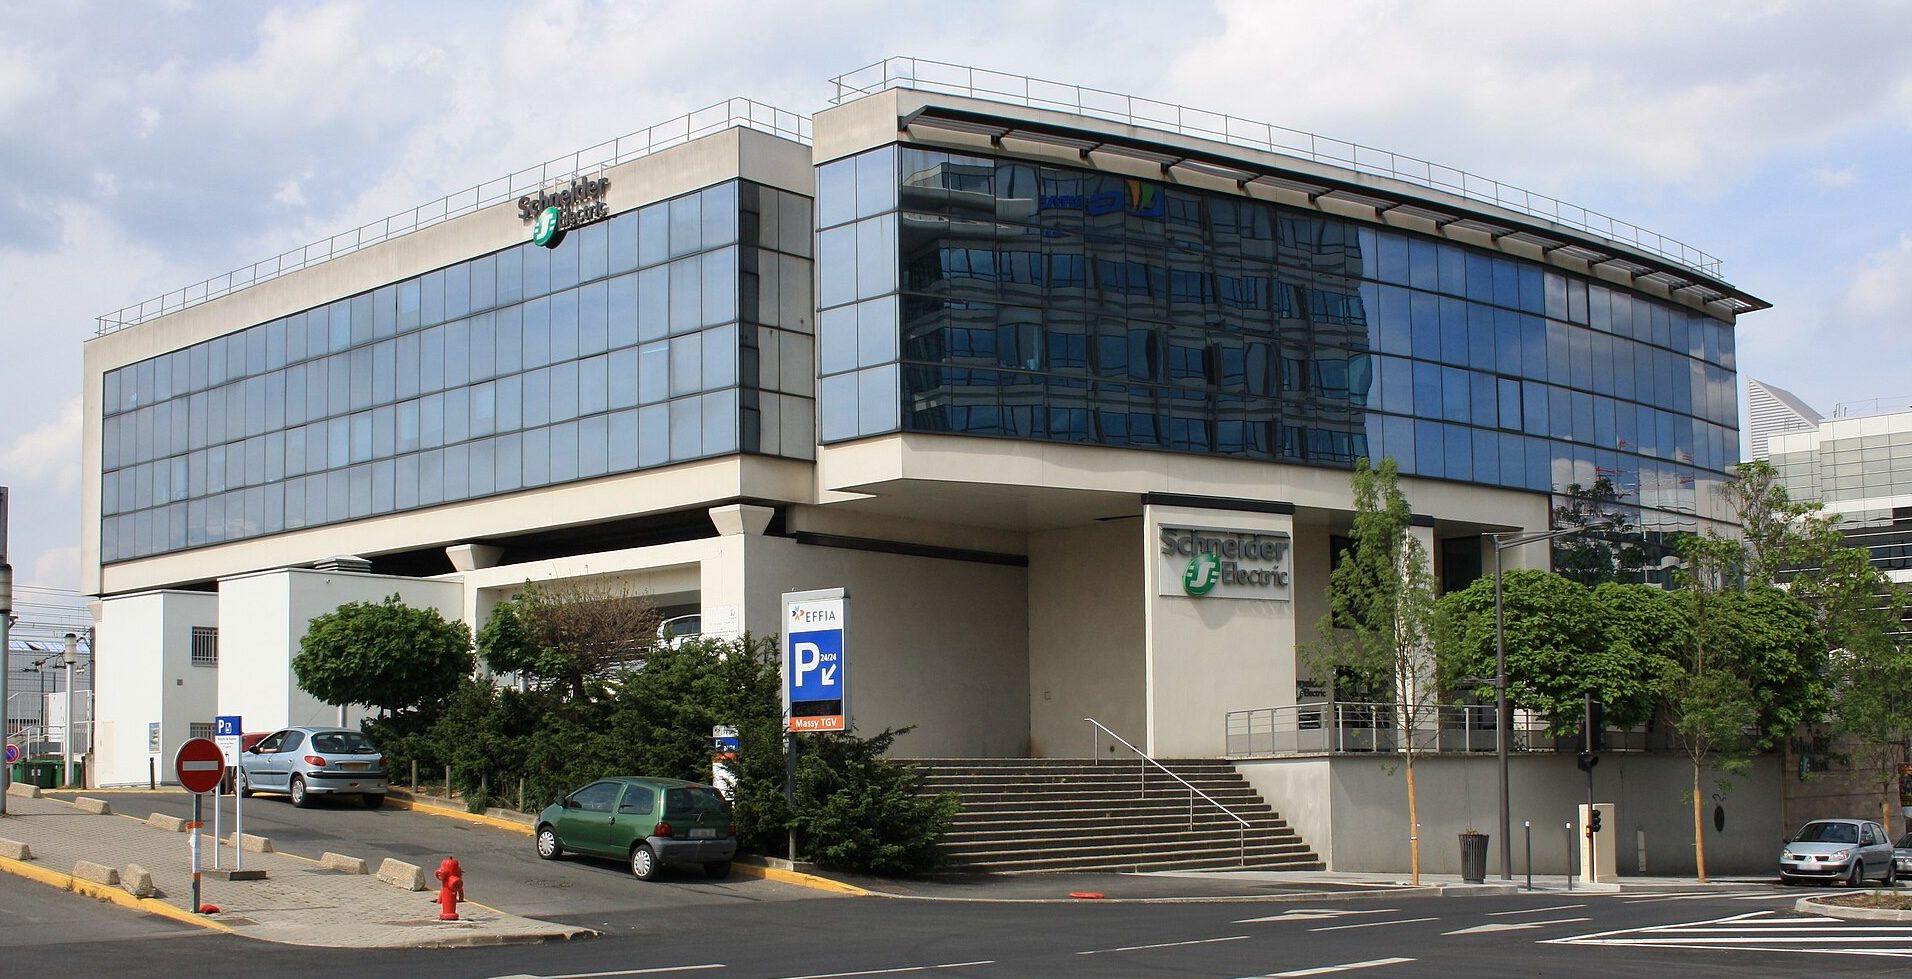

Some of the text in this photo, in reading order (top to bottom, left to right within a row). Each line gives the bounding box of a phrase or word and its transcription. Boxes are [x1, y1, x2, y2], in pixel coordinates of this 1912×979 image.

[518, 176, 608, 220] Schneider
[557, 201, 608, 230] Electric
[1161, 529, 1288, 562] Schneider
[1221, 561, 1288, 587] Electric
[805, 610, 836, 623] EFFIA
[795, 642, 837, 687] P 24/24
[218, 719, 225, 734] P
[795, 717, 837, 729] Massy TGV
